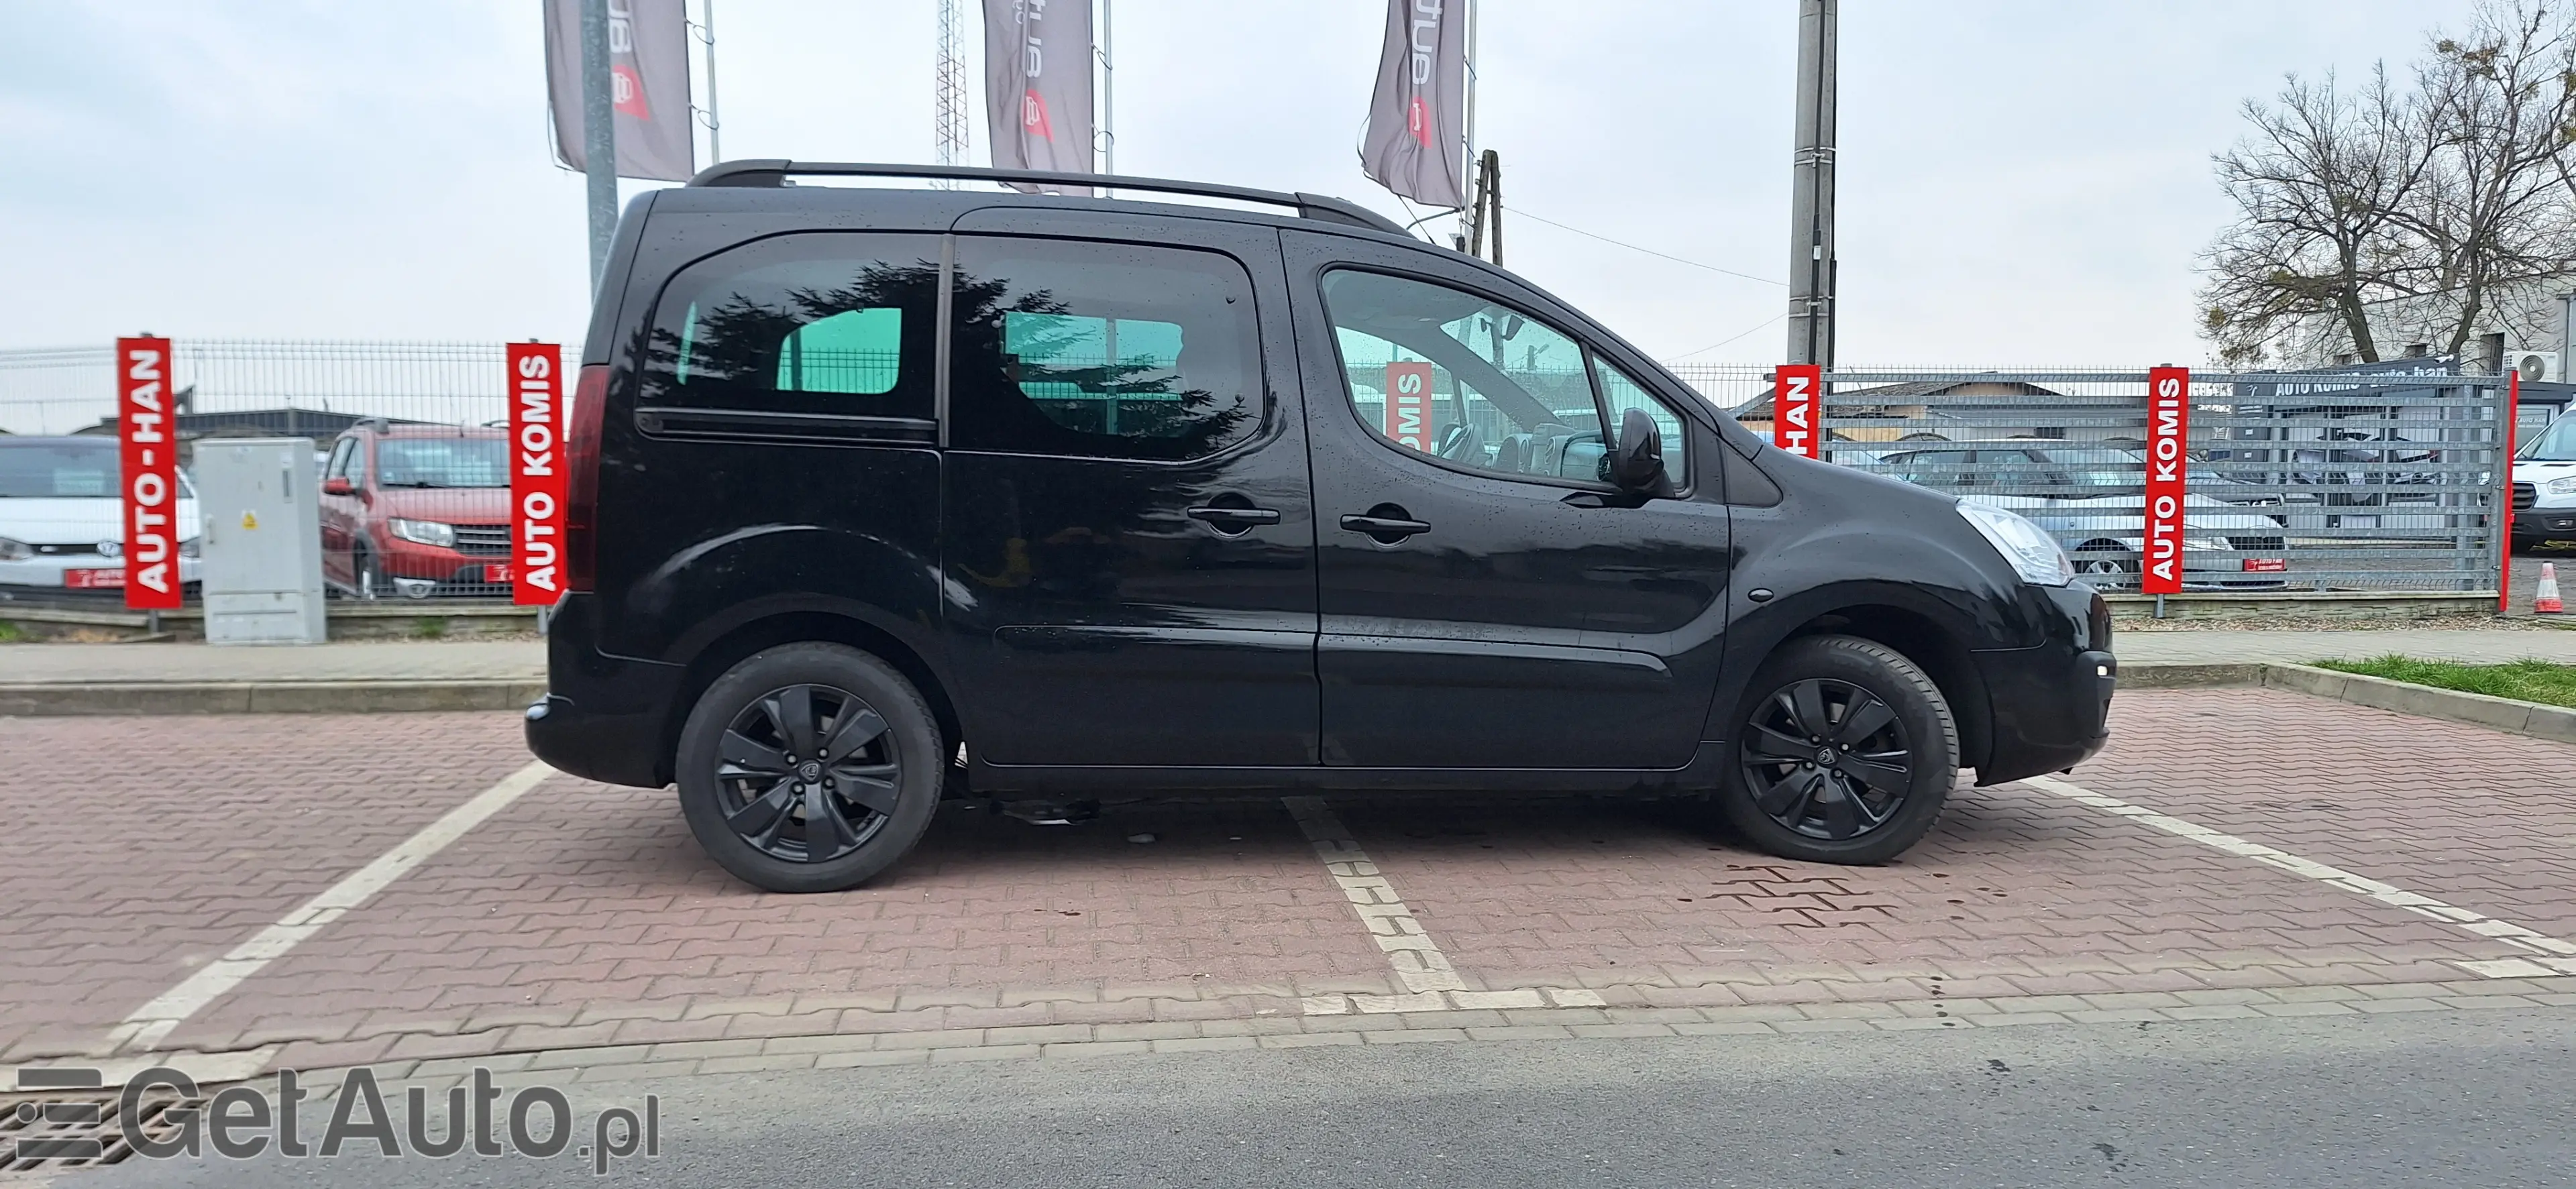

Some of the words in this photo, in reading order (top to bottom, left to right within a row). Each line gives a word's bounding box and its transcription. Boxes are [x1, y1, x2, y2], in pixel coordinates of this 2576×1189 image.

[519, 354, 553, 476] KOMIS
[1785, 377, 1810, 455] HAN
[2155, 378, 2180, 482] KOMIS
[129, 349, 169, 593] AUTO-HAN
[523, 492, 557, 592] AUTO
[2153, 496, 2176, 581] AUTO
